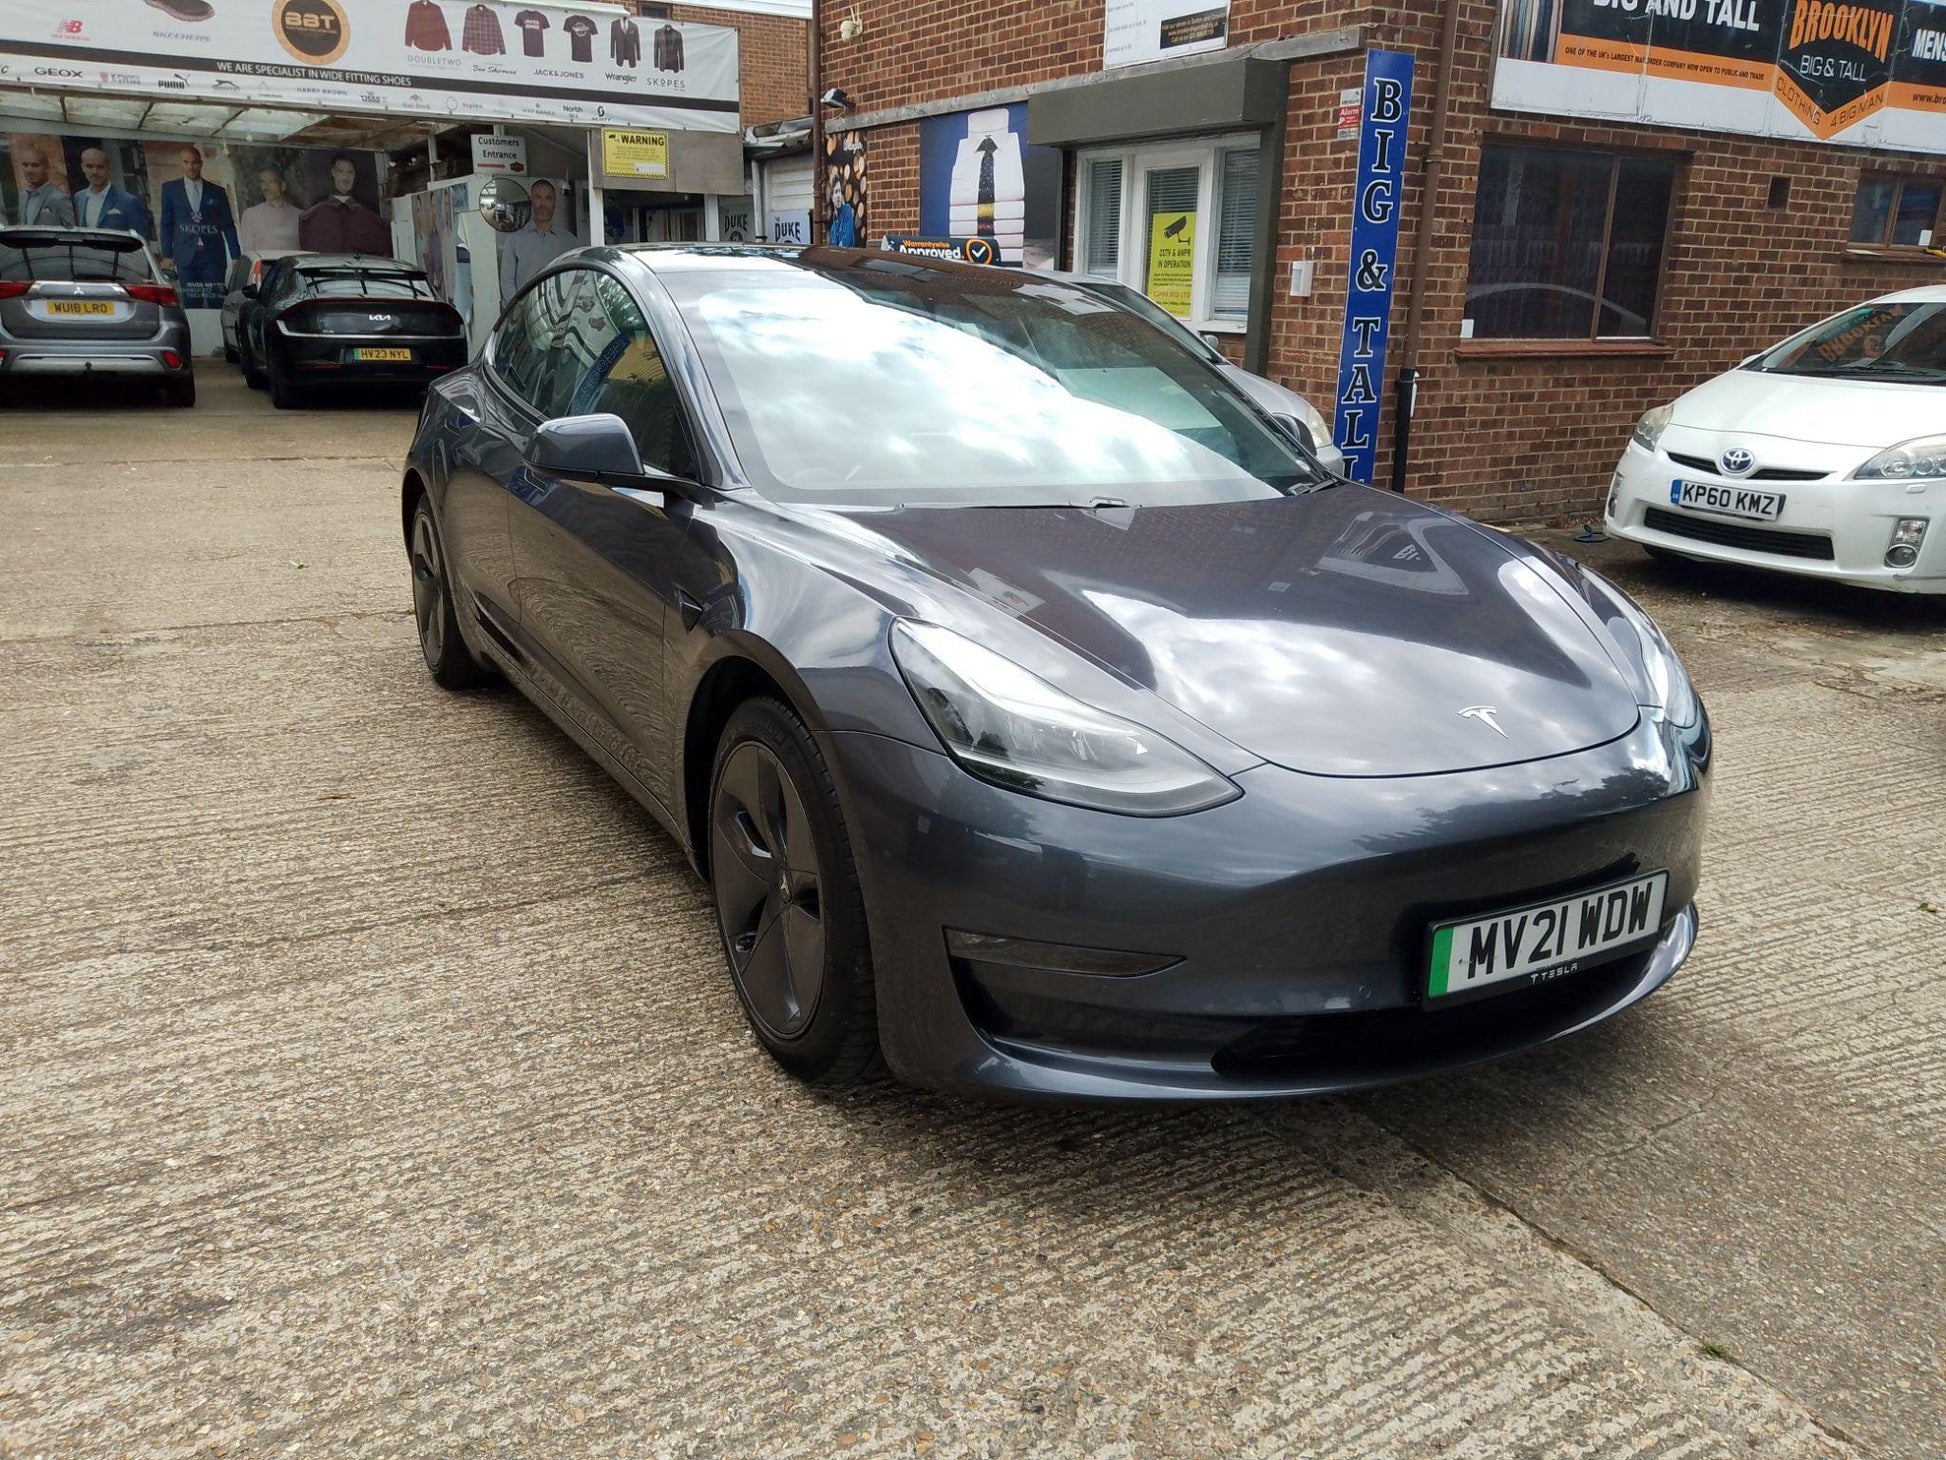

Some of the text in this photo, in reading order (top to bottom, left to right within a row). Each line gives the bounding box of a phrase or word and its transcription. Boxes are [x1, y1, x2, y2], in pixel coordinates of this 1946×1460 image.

[285, 11, 336, 30] BBT
[1706, 0, 1760, 31] TALL
[1789, 0, 1894, 64] BROOKLYN
[34, 66, 83, 78] GEOX
[1565, 46, 1576, 54] ONE
[1587, 49, 1597, 57] THE
[1611, 52, 1634, 62] LARGEST
[1663, 59, 1686, 70] COMPANY
[1687, 64, 1699, 72] NOW
[1699, 65, 1713, 73] OPEN
[1714, 66, 1720, 74] TO
[1721, 68, 1738, 76] PUBLIC
[1749, 72, 1764, 80] TRADE
[1838, 60, 1866, 82] TALL
[217, 61, 411, 87] WE ARE SPECIALIST IN WIDE FITTING SHOES
[605, 72, 637, 84] Wrangler
[646, 78, 685, 88] SKOPES
[157, 80, 185, 89] PUMA
[563, 104, 583, 113] North
[1776, 77, 1822, 126] CLOTHING
[1830, 93, 1884, 128] 4 BIG MAN
[478, 136, 520, 147] Customers
[621, 135, 665, 146] WARNING
[482, 149, 517, 160] Entrance
[1362, 77, 1403, 224] BIG
[178, 224, 219, 234] SKOPES
[724, 214, 748, 234] DUKE
[775, 221, 801, 243] DUKE
[903, 239, 950, 249] Warrantywise
[1164, 260, 1191, 269] OPERATION
[1356, 249, 1387, 292] &
[360, 349, 409, 359] HV23 NYL
[1682, 483, 1775, 515] KP60 KMZ
[1467, 882, 1653, 980] MV21 WDW
